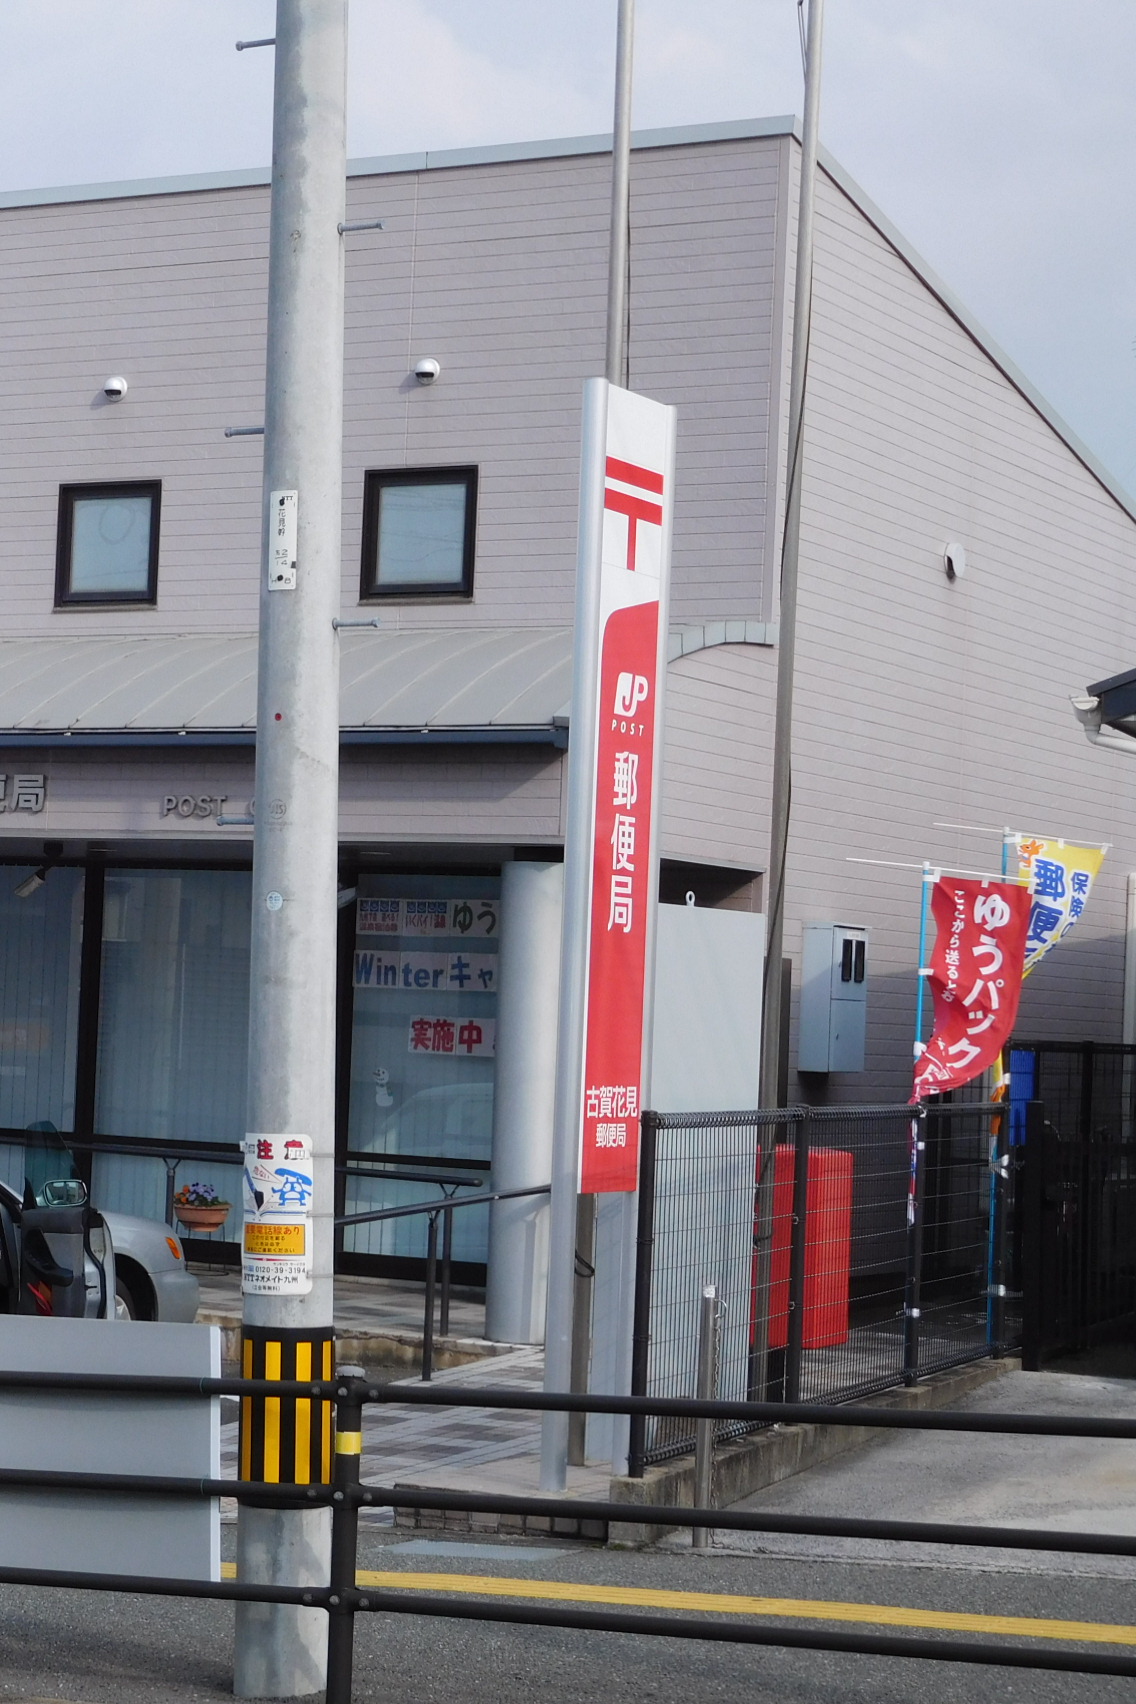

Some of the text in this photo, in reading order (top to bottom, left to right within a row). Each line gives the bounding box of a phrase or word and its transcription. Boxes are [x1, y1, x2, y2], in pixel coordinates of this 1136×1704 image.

[611, 718, 644, 738] POST
[163, 795, 227, 818] POST
[607, 750, 640, 934] 郵便局
[452, 901, 497, 935] ゆう
[945, 893, 1011, 1069] ゆうパック
[411, 1018, 483, 1054] 実施中
[586, 1085, 638, 1119] 古賀花見
[595, 1123, 627, 1149] 郵便局
